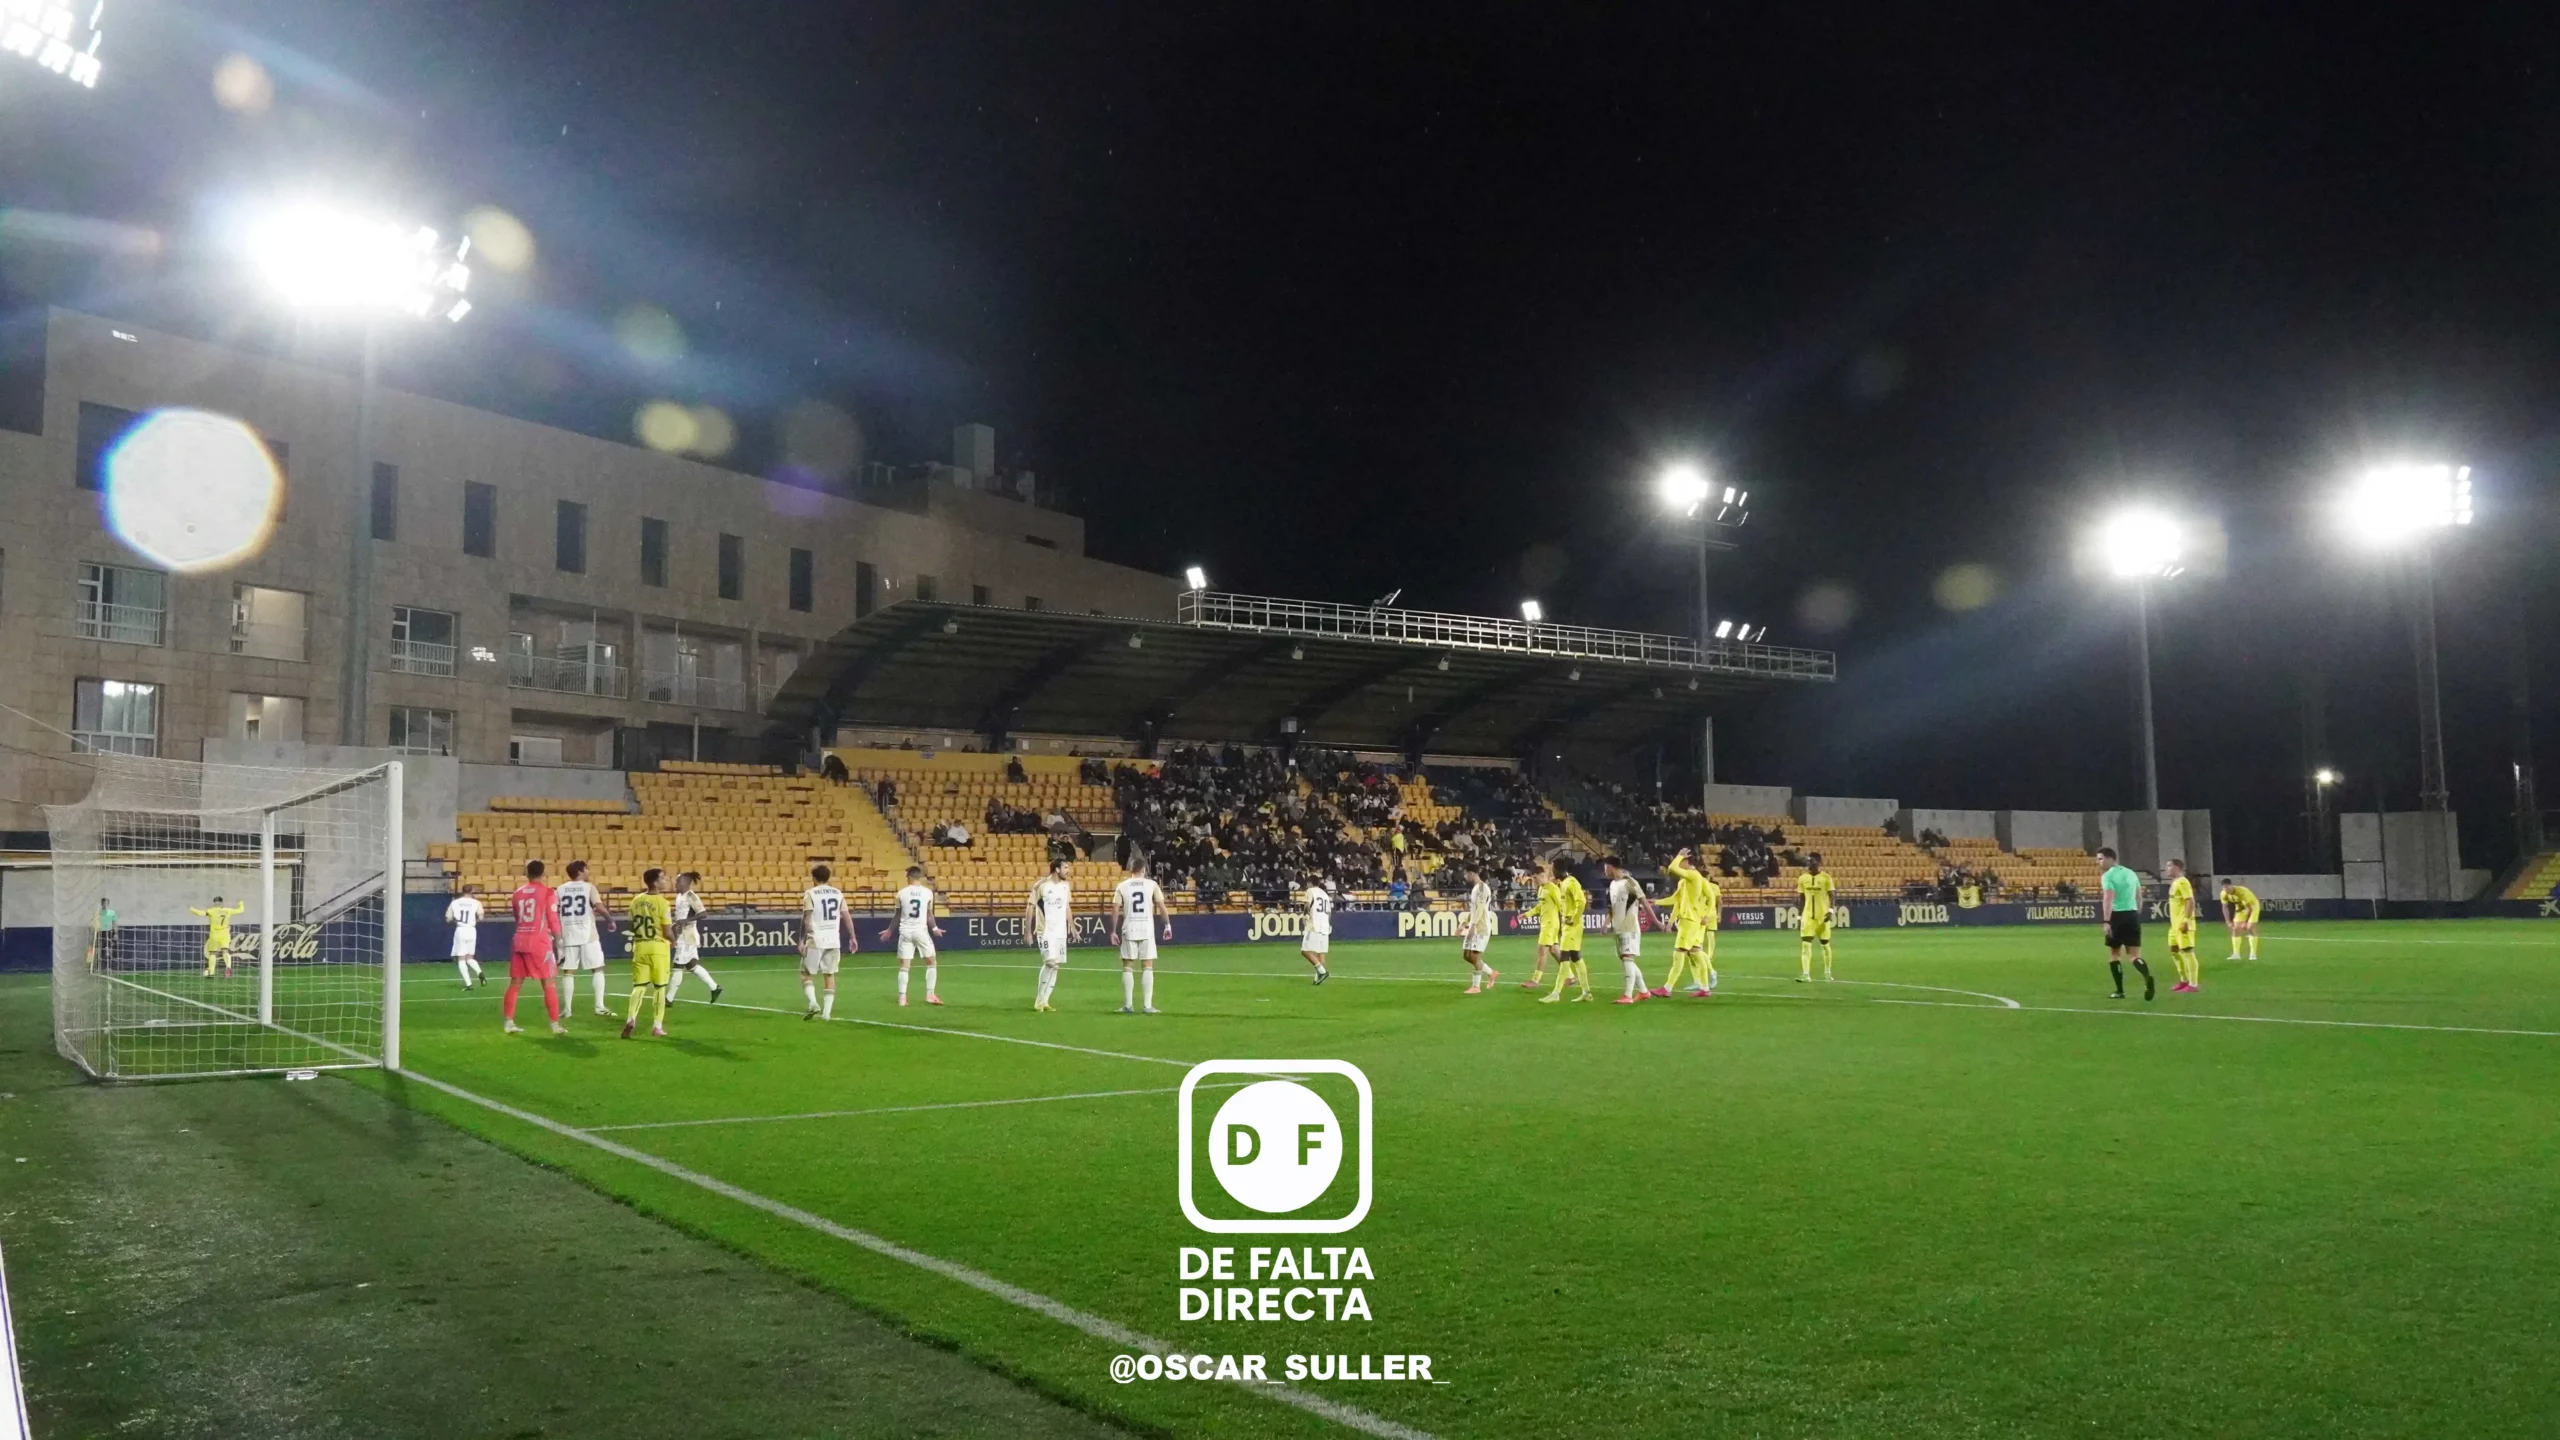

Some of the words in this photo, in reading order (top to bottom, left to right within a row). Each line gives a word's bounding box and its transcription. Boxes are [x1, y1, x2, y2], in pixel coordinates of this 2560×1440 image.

[518, 898, 536, 923] 13
[561, 895, 586, 916] 23
[821, 898, 838, 920] 12
[908, 899, 921, 918] 3
[1132, 891, 1144, 913] 2
[219, 914, 226, 927] 7
[460, 910, 470, 924] 11
[632, 914, 657, 939] 26
[1736, 912, 1764, 921] VERSUS
[969, 918, 989, 936] EL
